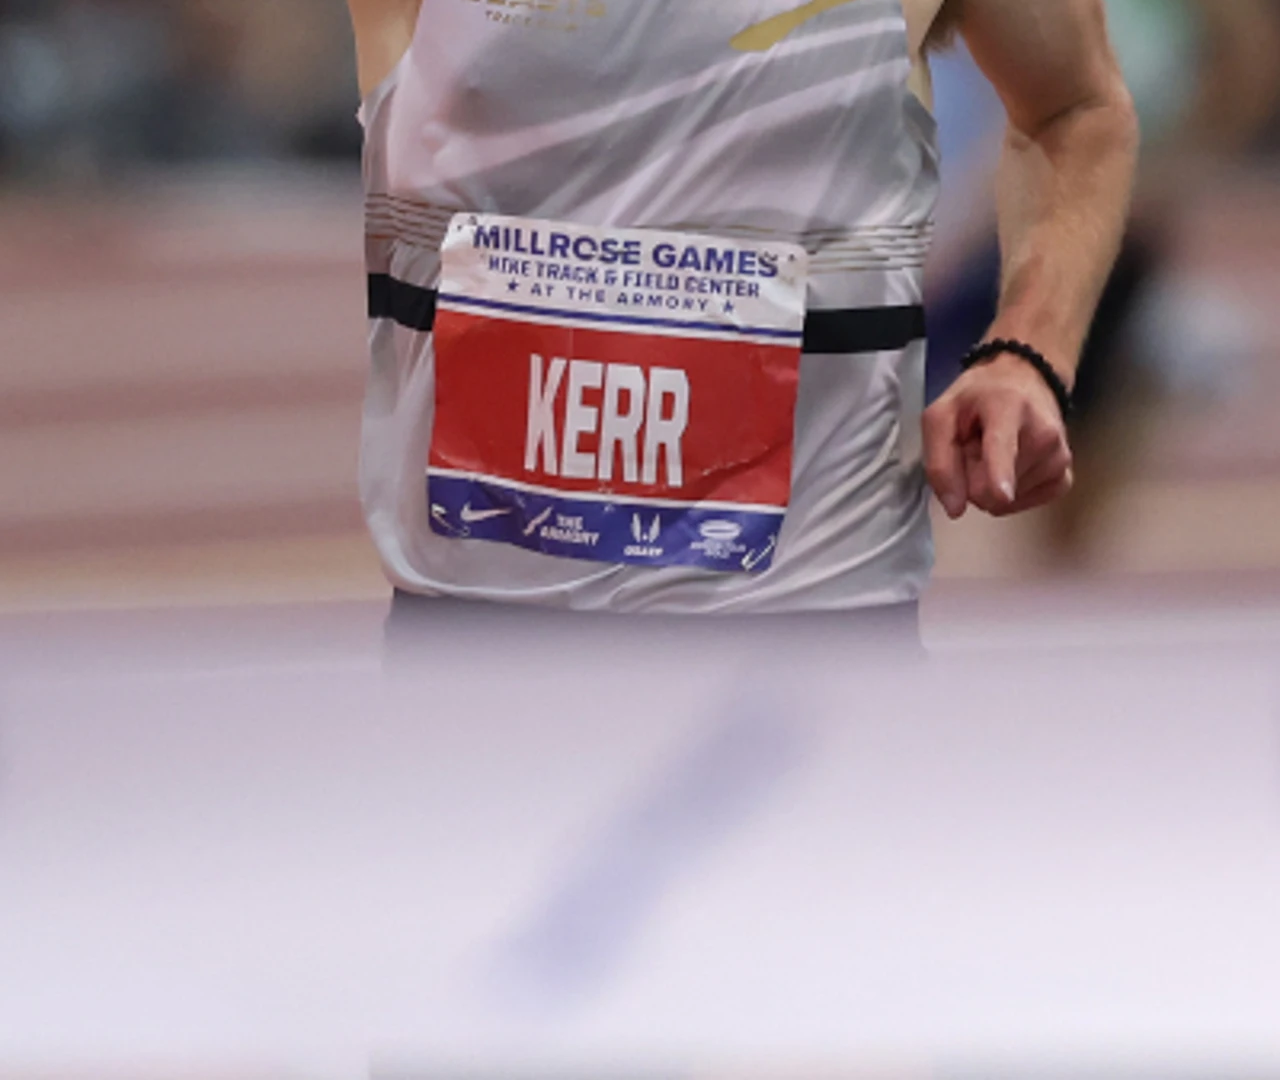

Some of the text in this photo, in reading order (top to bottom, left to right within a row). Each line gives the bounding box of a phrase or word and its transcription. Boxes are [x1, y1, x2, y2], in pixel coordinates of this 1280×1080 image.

[473, 224, 779, 278] MILLROSE GAMES
[488, 254, 760, 298] NIKE TRACK & FIELD CENTER
[530, 282, 709, 312] AT THE ARMORY
[523, 352, 691, 488] KERR
